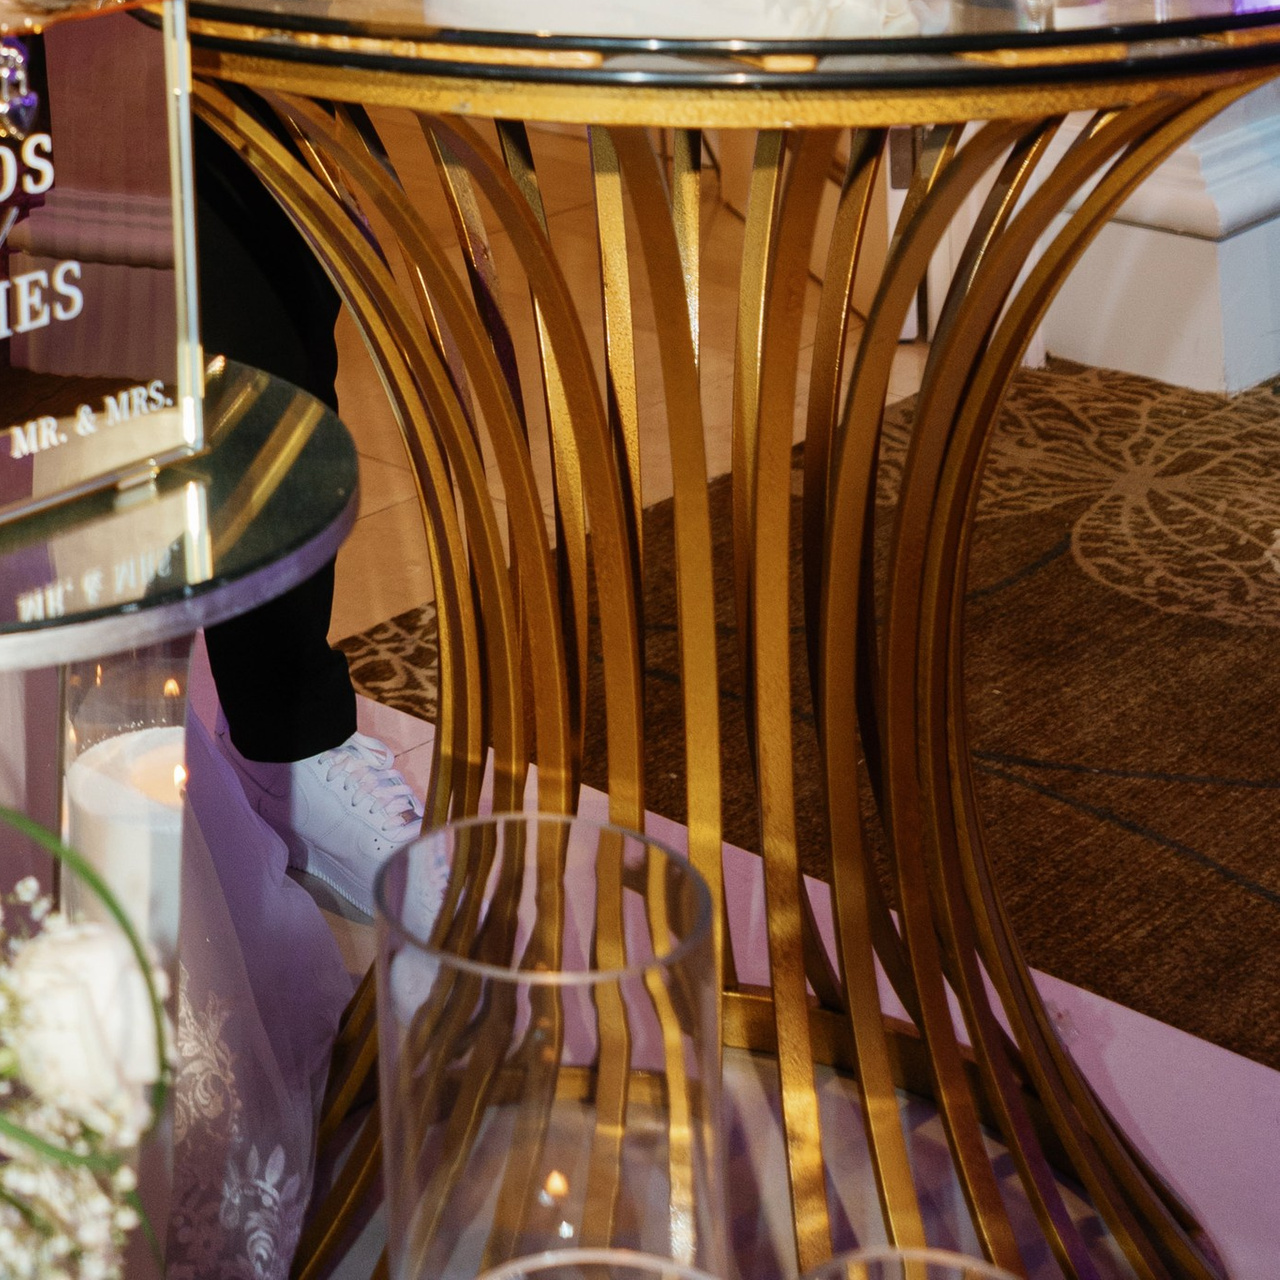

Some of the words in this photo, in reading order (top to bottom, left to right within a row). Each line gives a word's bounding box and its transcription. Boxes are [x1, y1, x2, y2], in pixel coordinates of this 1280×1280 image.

[10, 416, 68, 459] MR.
[75, 404, 97, 437] &
[103, 379, 173, 427] MRS.
